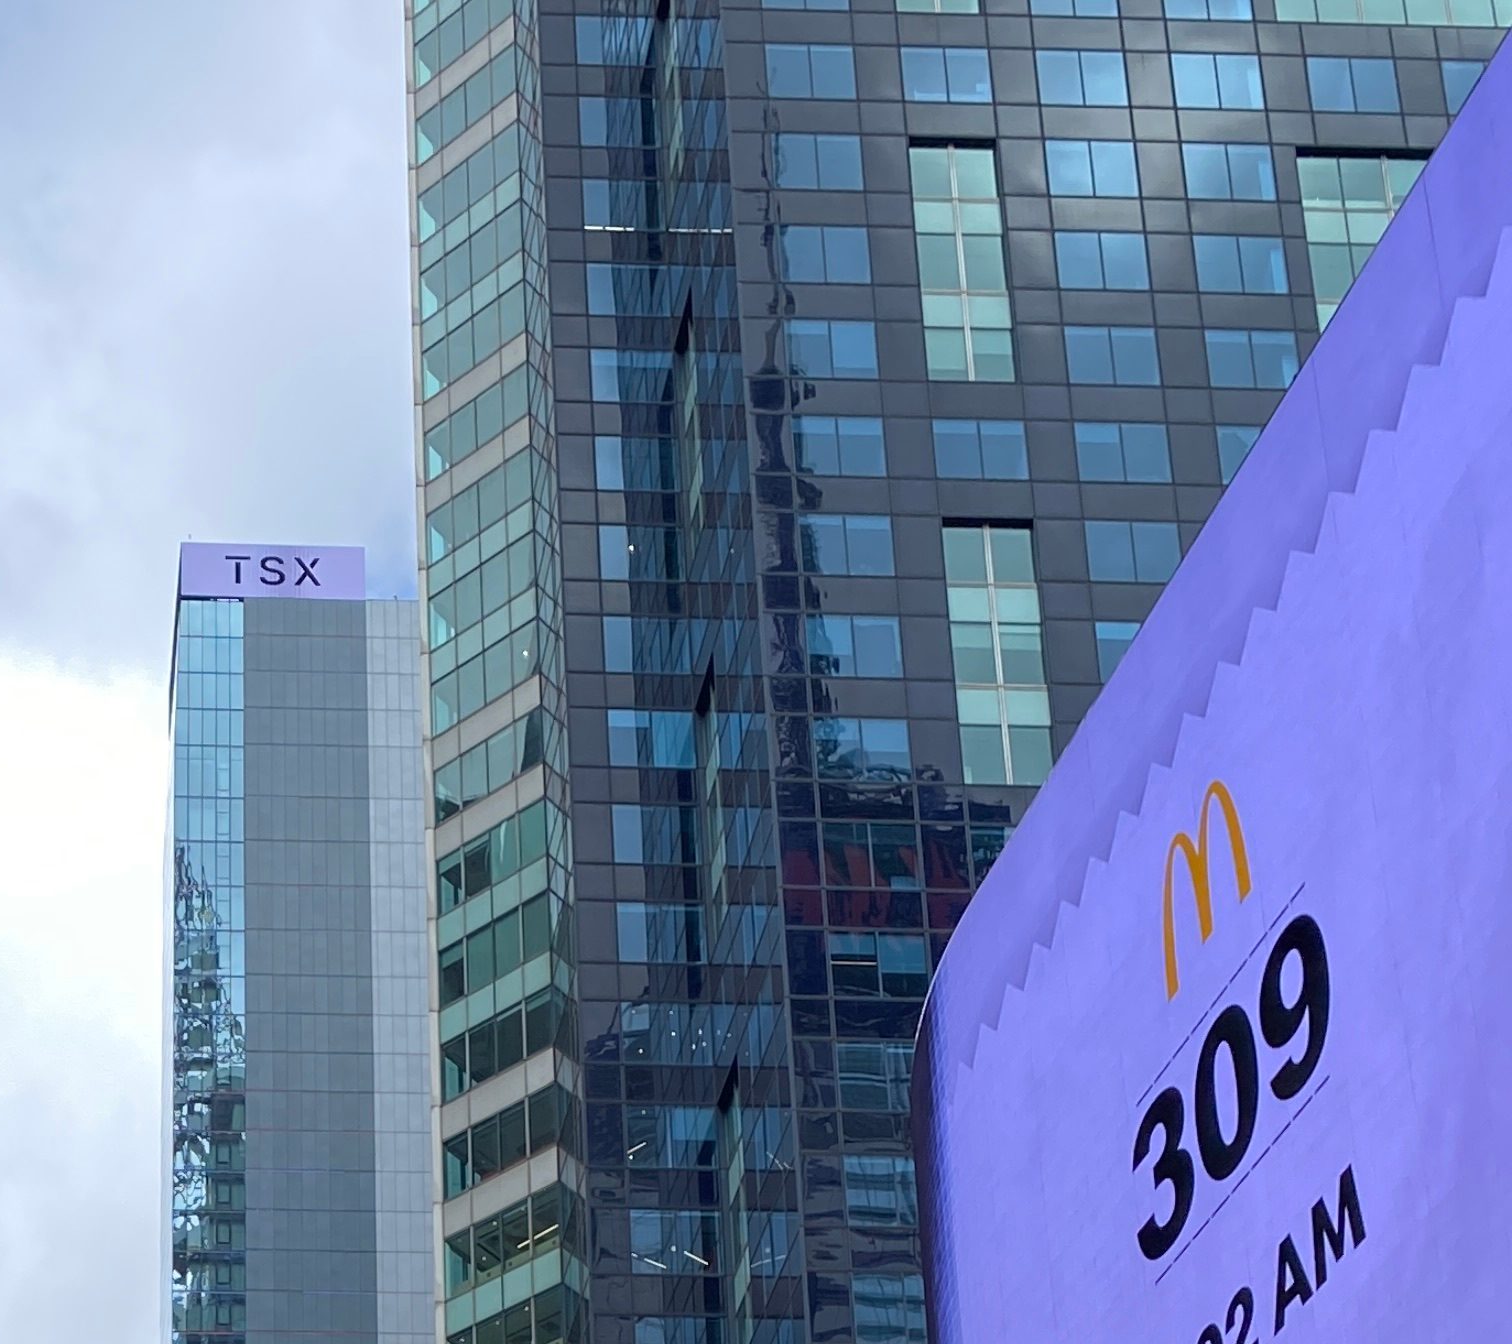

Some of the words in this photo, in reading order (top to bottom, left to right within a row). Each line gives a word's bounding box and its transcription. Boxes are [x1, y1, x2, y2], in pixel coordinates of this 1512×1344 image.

[225, 555, 321, 587] TSX
[1133, 914, 1332, 1262] 309
[1274, 1166, 1367, 1334] AM
